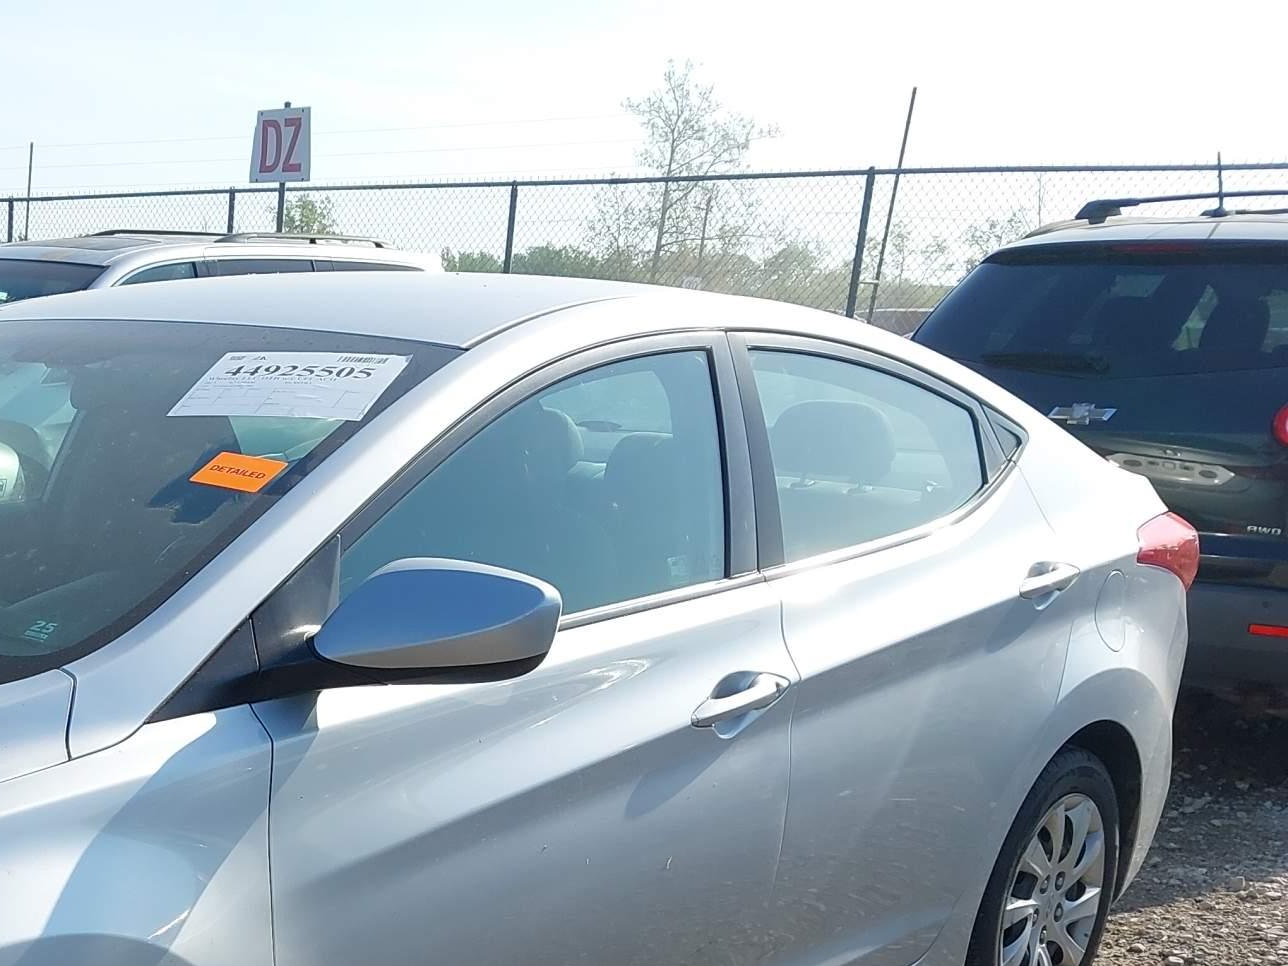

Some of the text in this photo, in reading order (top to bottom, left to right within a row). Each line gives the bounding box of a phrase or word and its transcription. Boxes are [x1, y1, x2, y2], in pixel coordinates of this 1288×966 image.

[258, 116, 303, 174] DZ
[224, 364, 377, 380] 44925505
[209, 464, 267, 480] DETAILED
